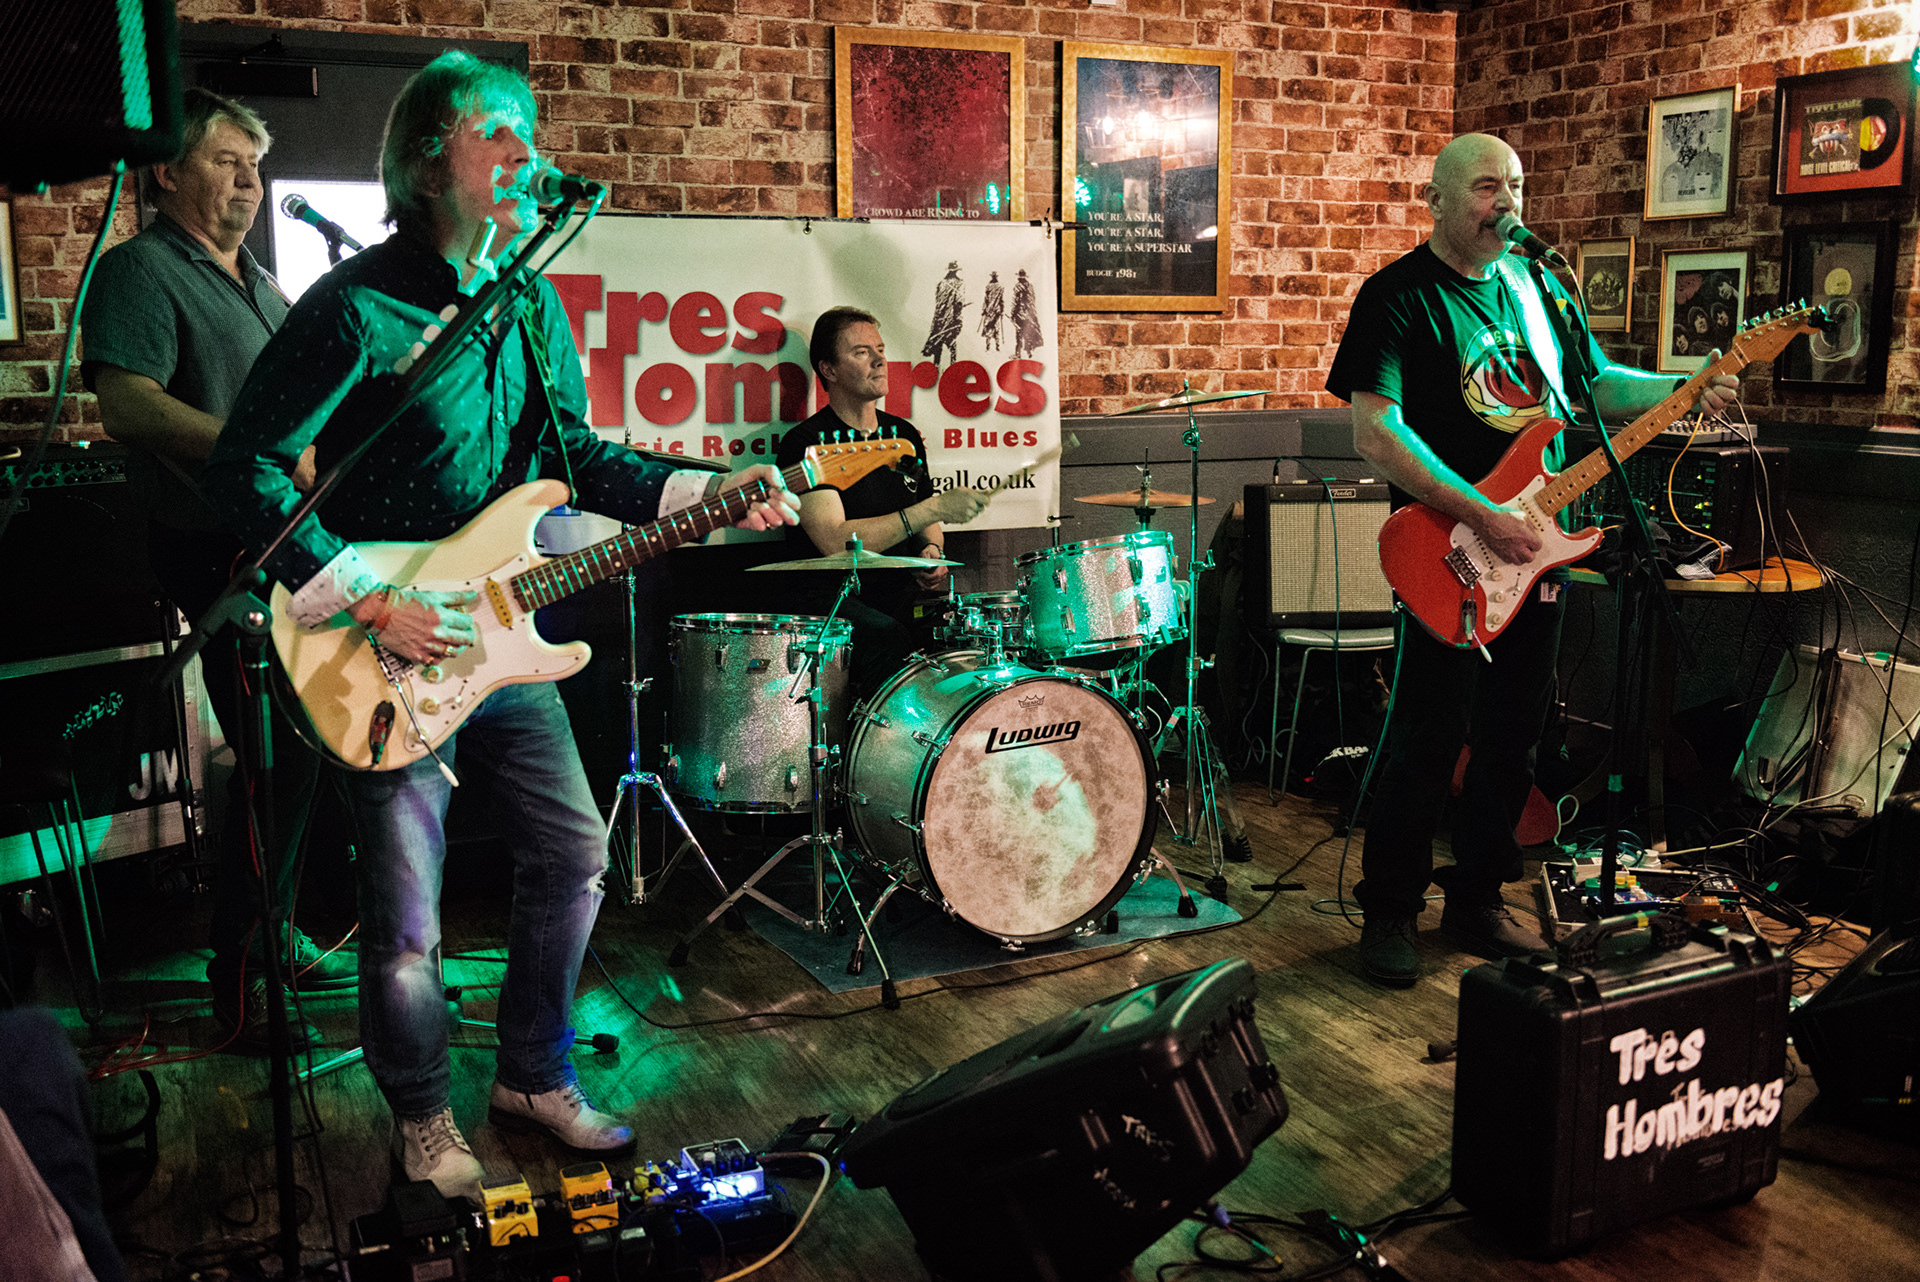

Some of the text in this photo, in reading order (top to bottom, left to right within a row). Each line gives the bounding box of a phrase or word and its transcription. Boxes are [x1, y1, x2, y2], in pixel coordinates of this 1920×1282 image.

[865, 207, 980, 219] CROWD ARE RISING TO
[1087, 211, 1164, 223] YOU'RE A STAR,
[1087, 226, 1164, 238] YOU'RE A STAR,
[1087, 241, 1192, 253] YOU'RE A SUPERSTAR
[1086, 268, 1137, 278] BUDGIE 1981
[542, 273, 788, 355] Tres
[943, 427, 1038, 449] Blues
[1022, 699, 1042, 707] REMO
[1610, 1027, 1706, 1086] Tres
[1603, 1077, 1785, 1161] Hombres
